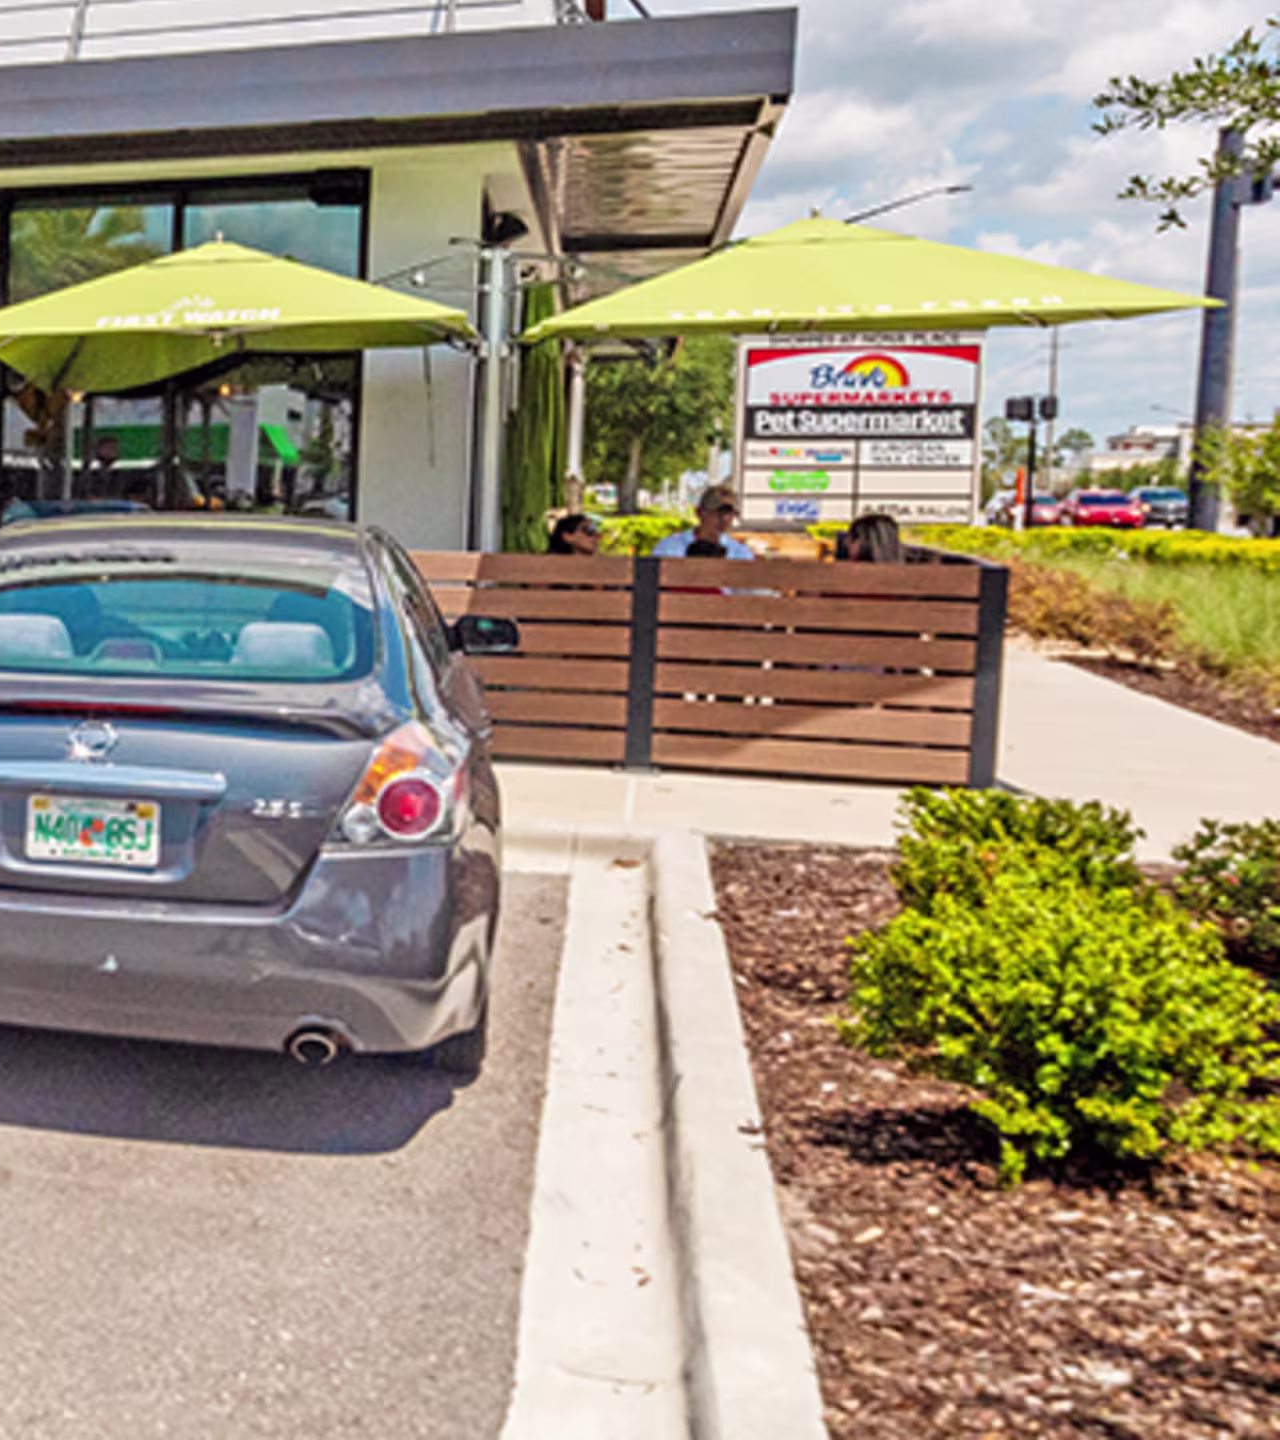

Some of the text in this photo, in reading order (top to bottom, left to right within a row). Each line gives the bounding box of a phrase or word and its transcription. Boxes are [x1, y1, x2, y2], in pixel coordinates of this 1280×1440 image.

[95, 307, 281, 329] FIRST WATCH
[768, 391, 953, 406] SUPERMARKETS
